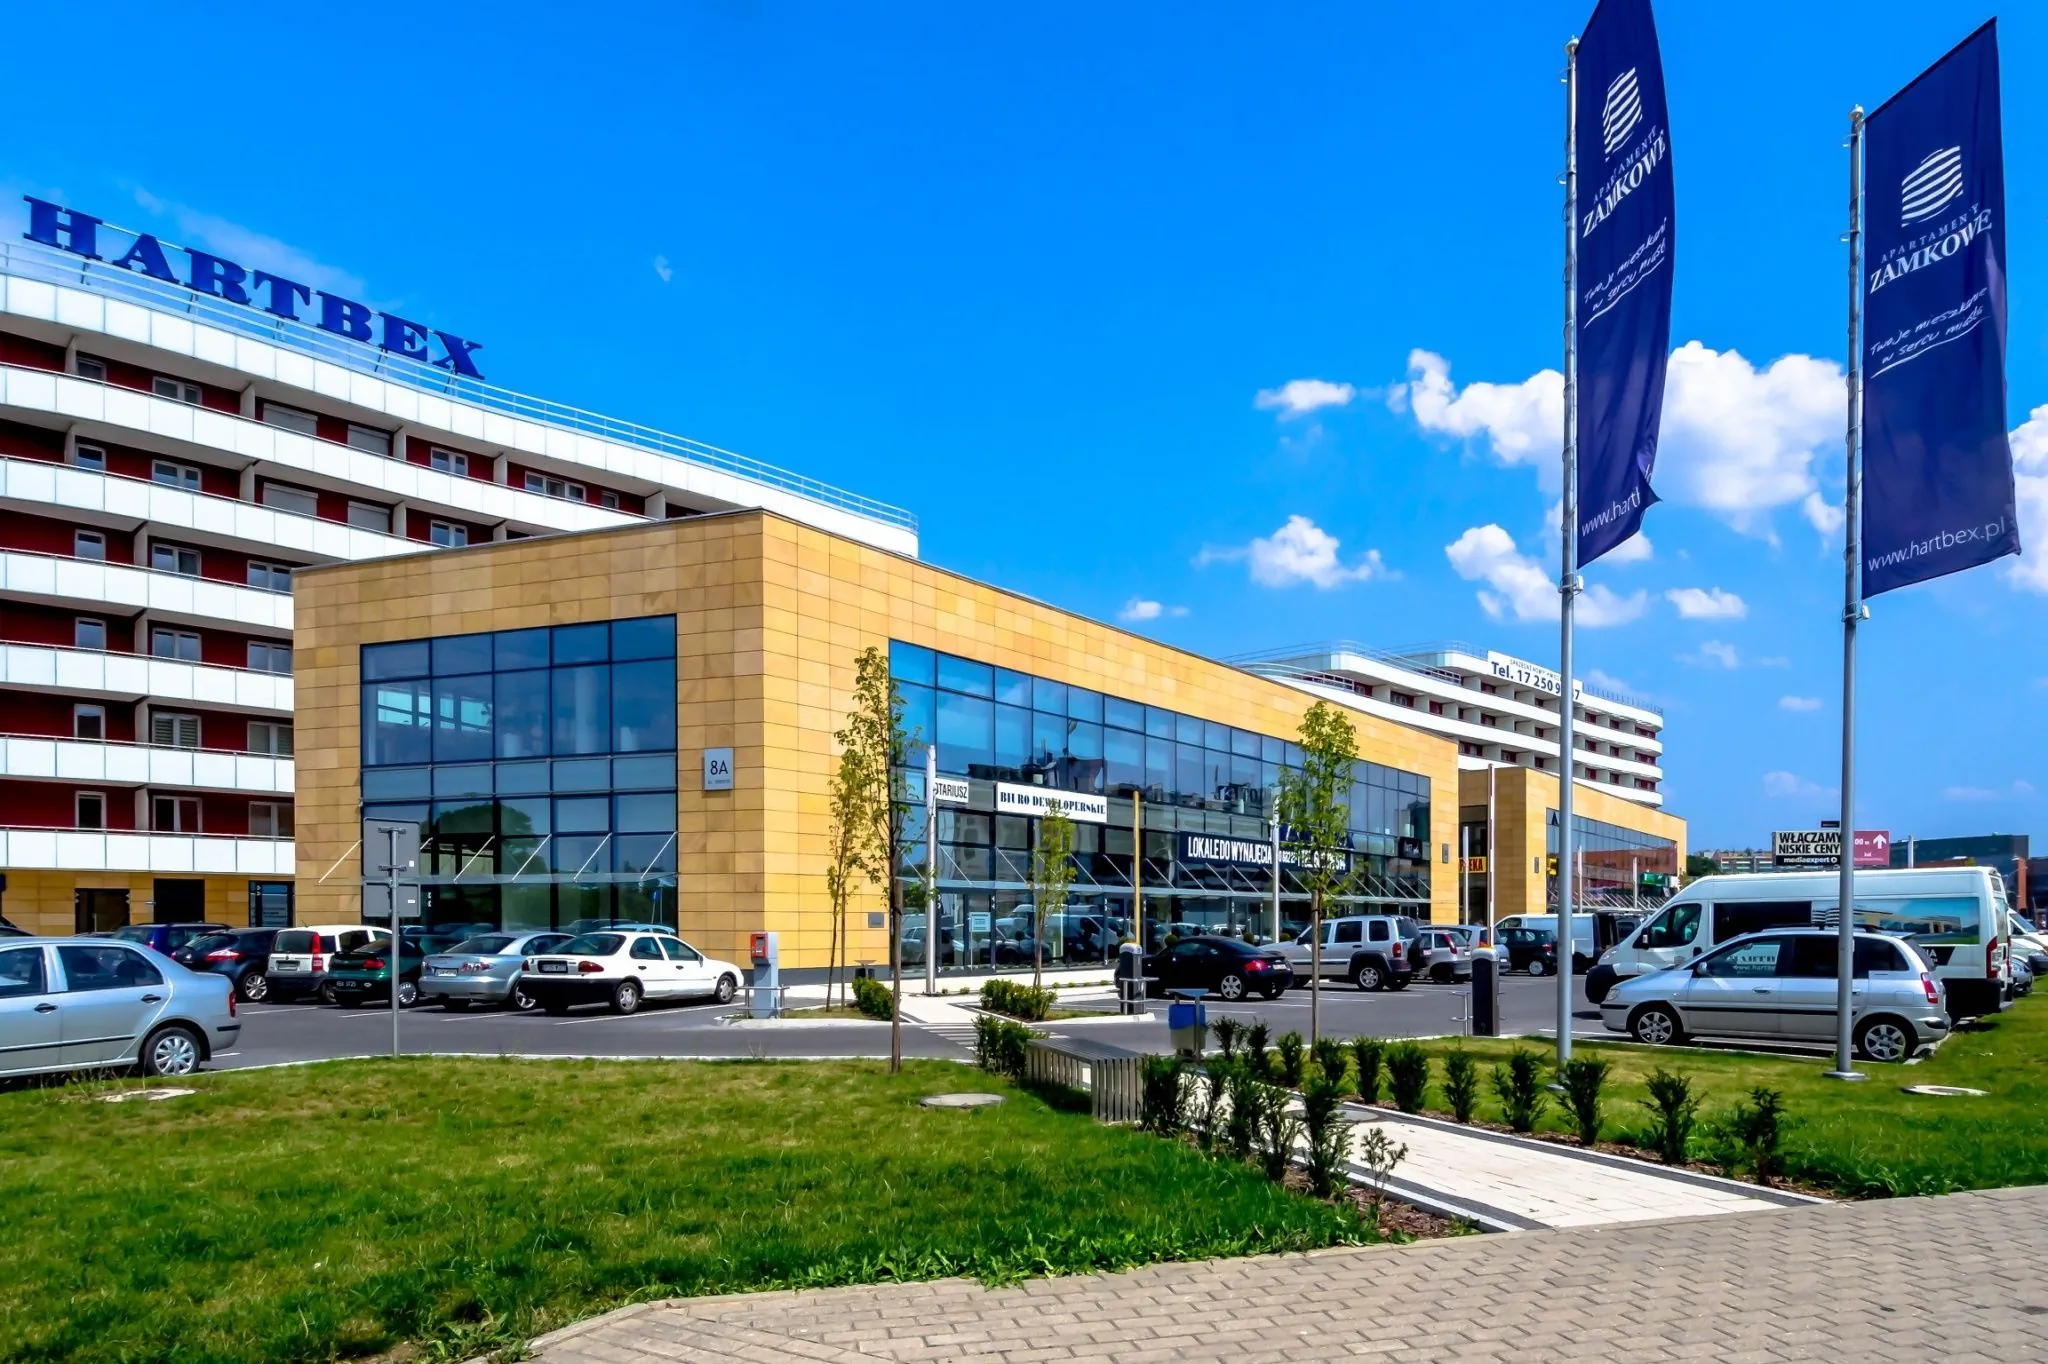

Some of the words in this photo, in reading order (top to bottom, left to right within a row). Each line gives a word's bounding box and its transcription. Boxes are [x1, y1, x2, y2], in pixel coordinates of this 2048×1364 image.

[1881, 202, 1979, 264] APARTAMENY
[1870, 208, 1992, 294] ZAMKOWE
[23, 195, 485, 380] HARTBEX
[1868, 515, 2005, 572] www.hartbex.pl
[1491, 661, 1514, 679] Tel.
[1517, 669, 1531, 684] 17
[1533, 674, 1553, 692] 250
[710, 760, 729, 775] 8A
[1000, 792, 1030, 806] BIURO
[1188, 836, 1219, 859] LOKALE
[1220, 840, 1230, 860] DO
[1779, 844, 1810, 854] NISKIE
[1814, 844, 1840, 854] CENY
